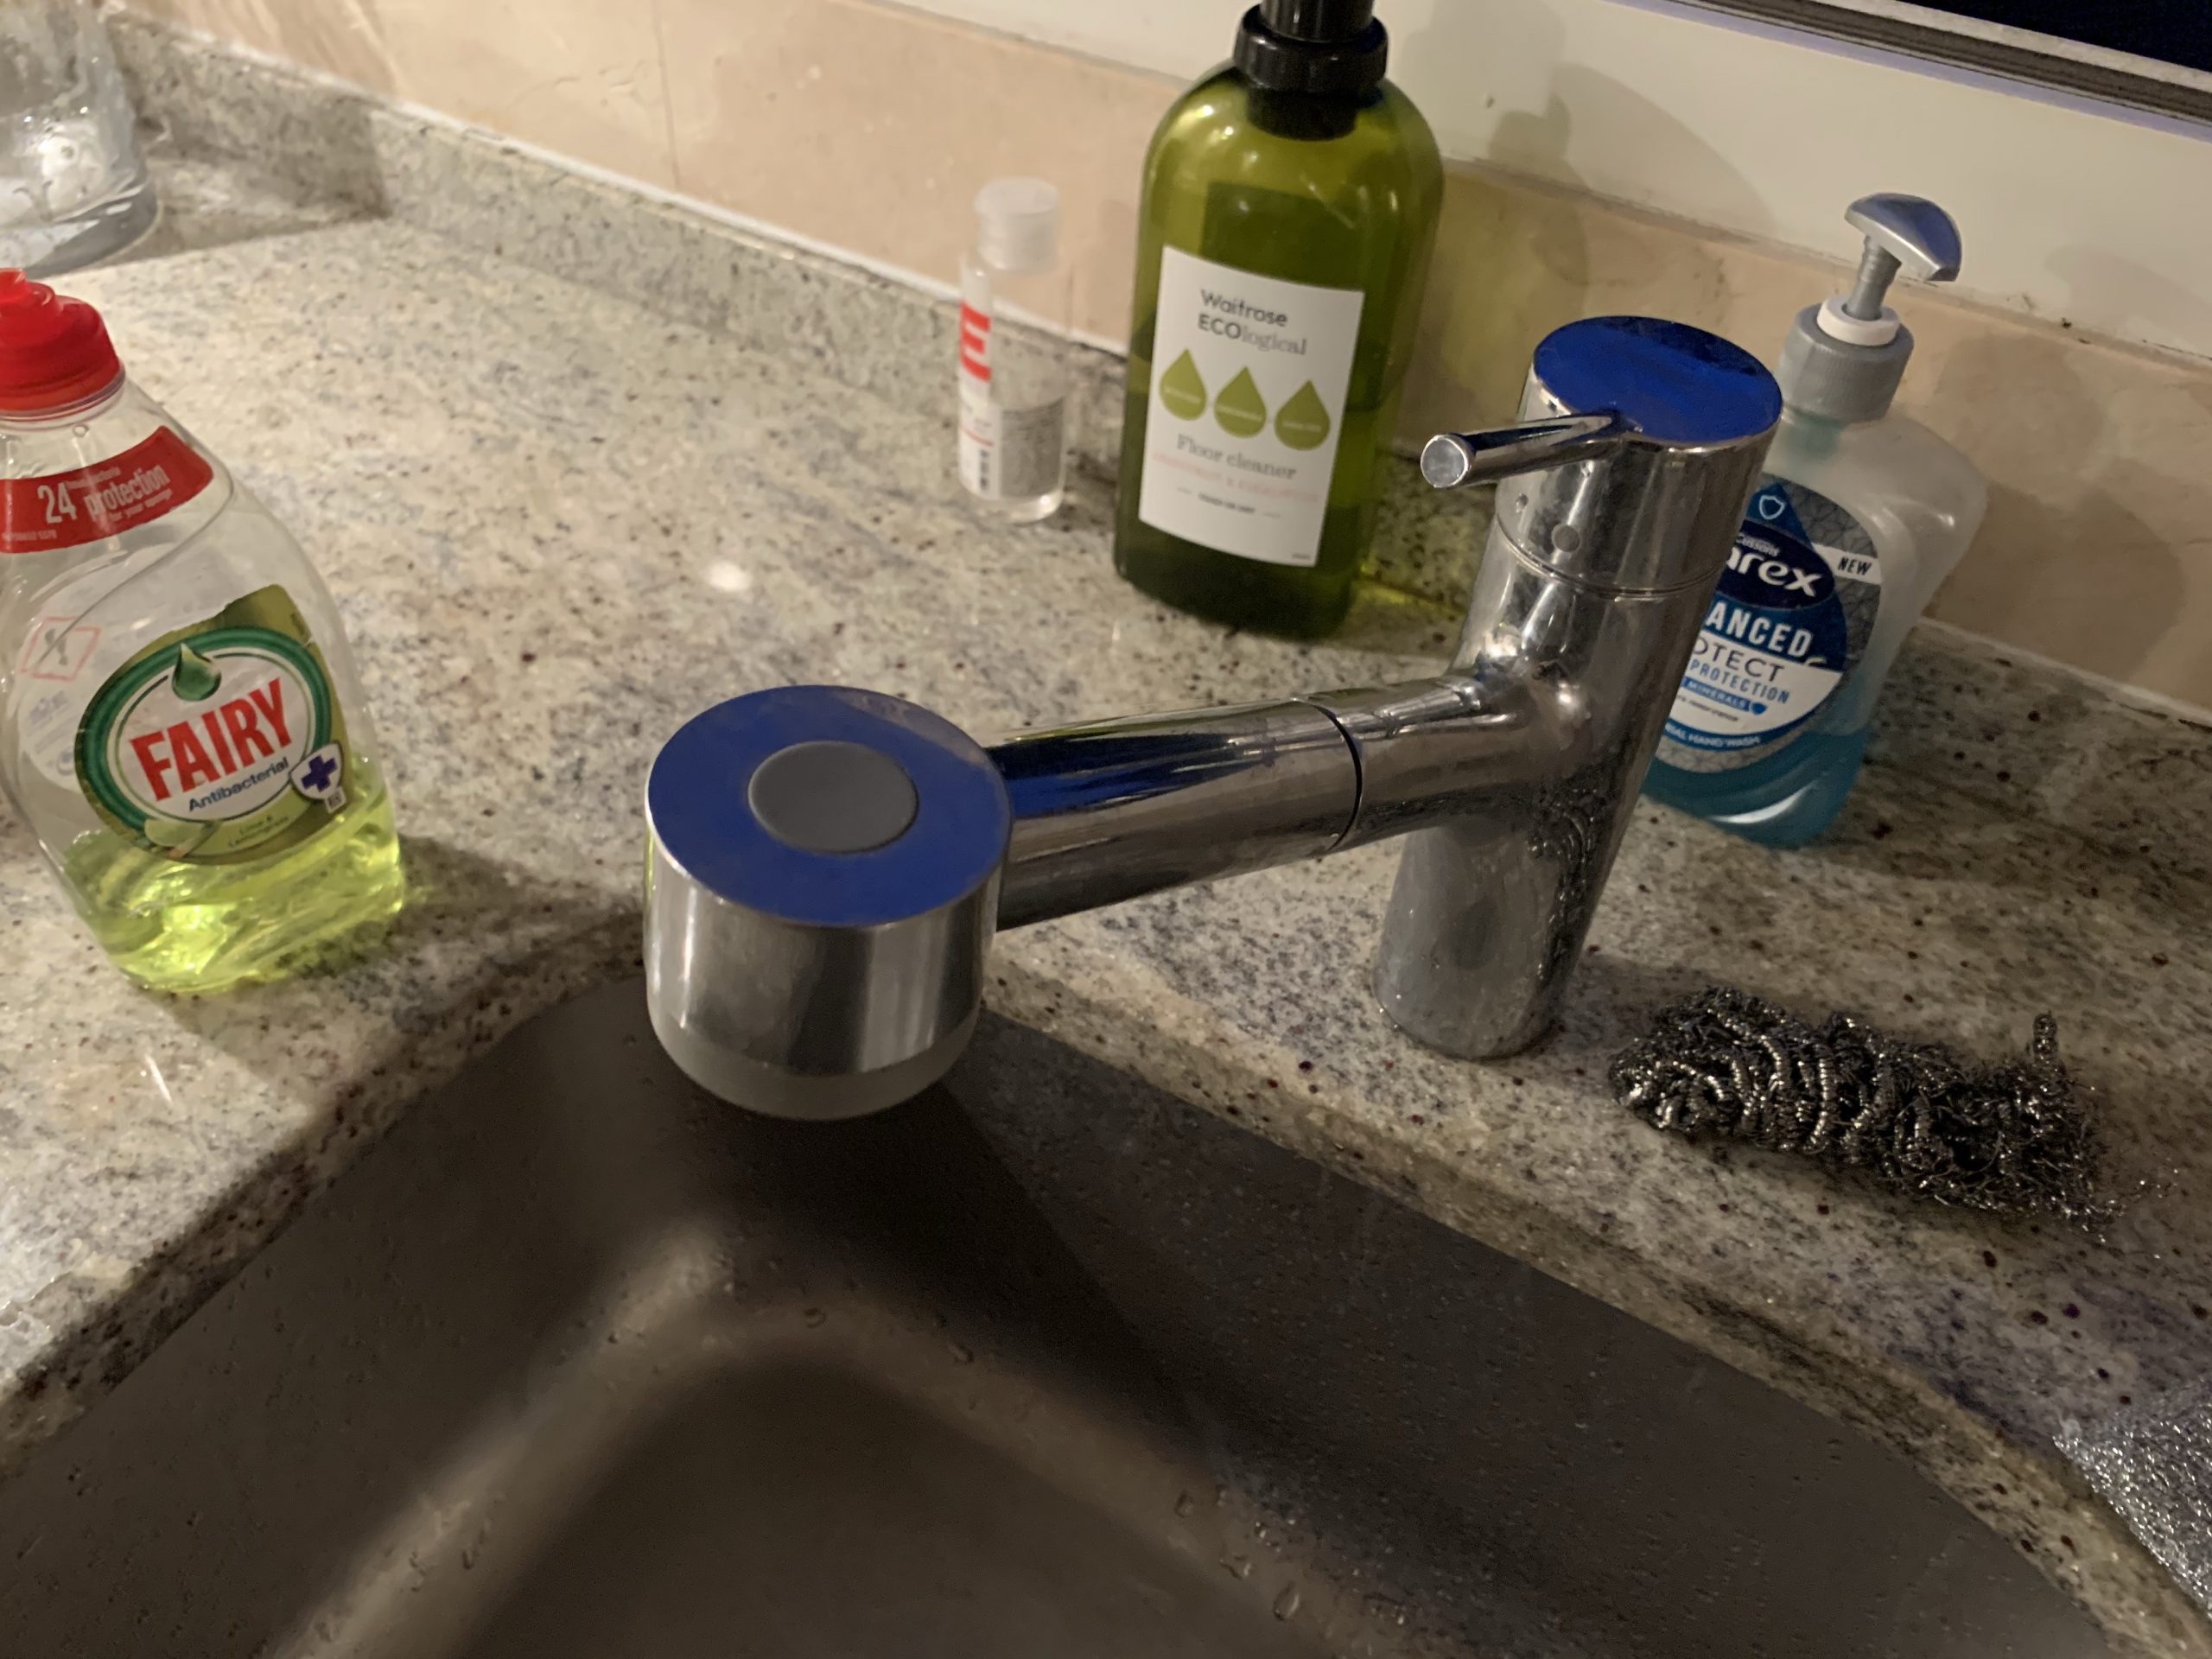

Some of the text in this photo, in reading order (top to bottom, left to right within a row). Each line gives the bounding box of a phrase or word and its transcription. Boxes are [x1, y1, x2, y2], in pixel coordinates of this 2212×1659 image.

[1200, 288, 1288, 327] Waitrose
[1198, 313, 1307, 356] ECOlogical
[1176, 433, 1223, 462] Floor
[1227, 449, 1298, 480] cleaner
[36, 481, 78, 524] 24
[83, 464, 171, 523] protection
[1837, 556, 1873, 577] NEW
[1705, 601, 1815, 658] ANCED
[1690, 658, 1791, 704] PROTECTION
[130, 677, 292, 802] FAIRY
[188, 756, 290, 812] Antibacterial
